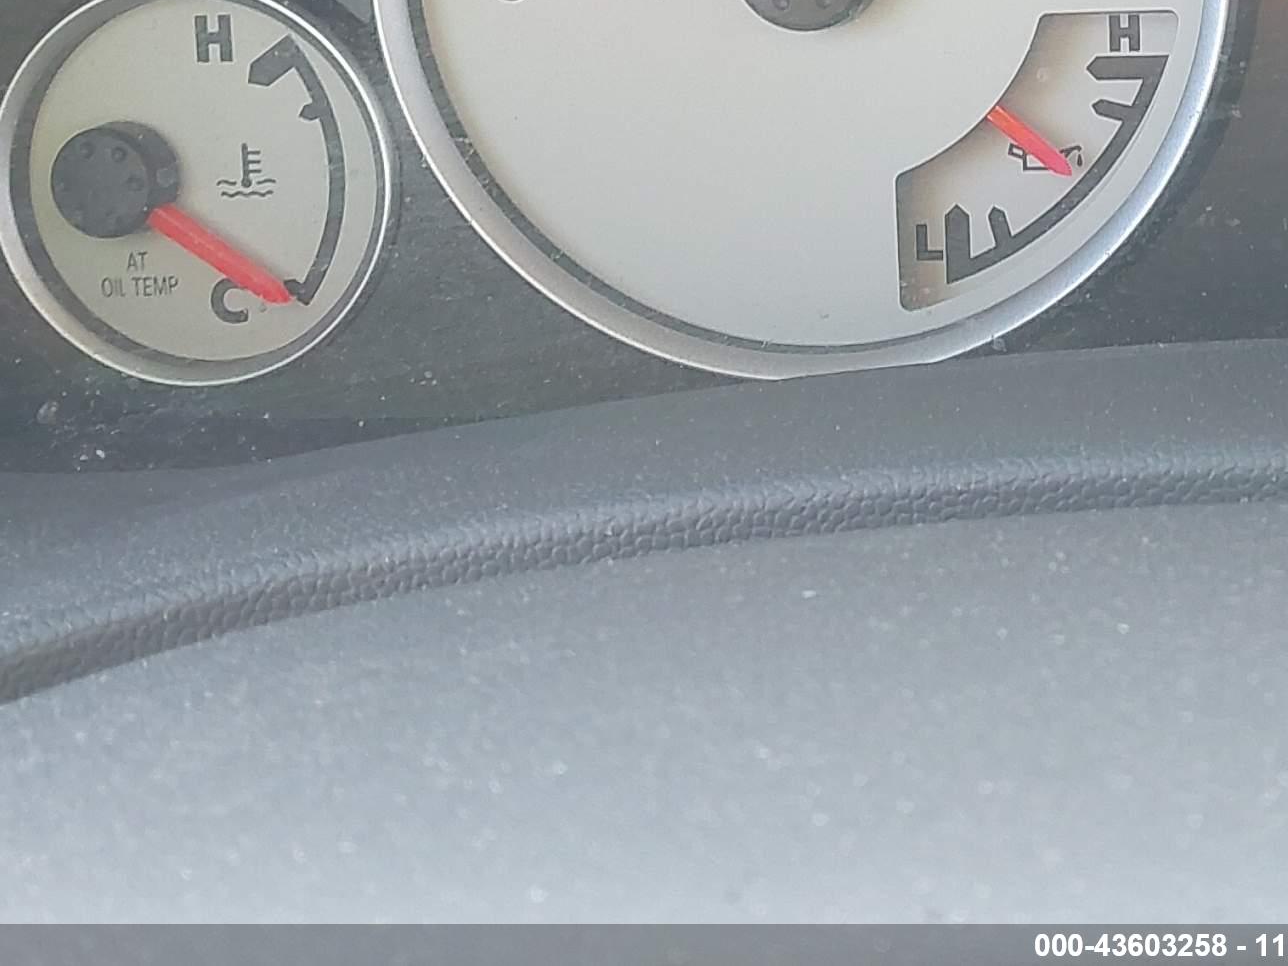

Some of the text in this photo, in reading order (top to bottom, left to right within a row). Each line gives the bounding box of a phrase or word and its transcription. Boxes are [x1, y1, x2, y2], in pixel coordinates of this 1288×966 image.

[194, 14, 233, 63] H
[1108, 14, 1140, 52] H
[127, 252, 147, 270] AT
[916, 223, 943, 261] L
[101, 277, 178, 297] OIL TEMP
[210, 278, 249, 324] C
